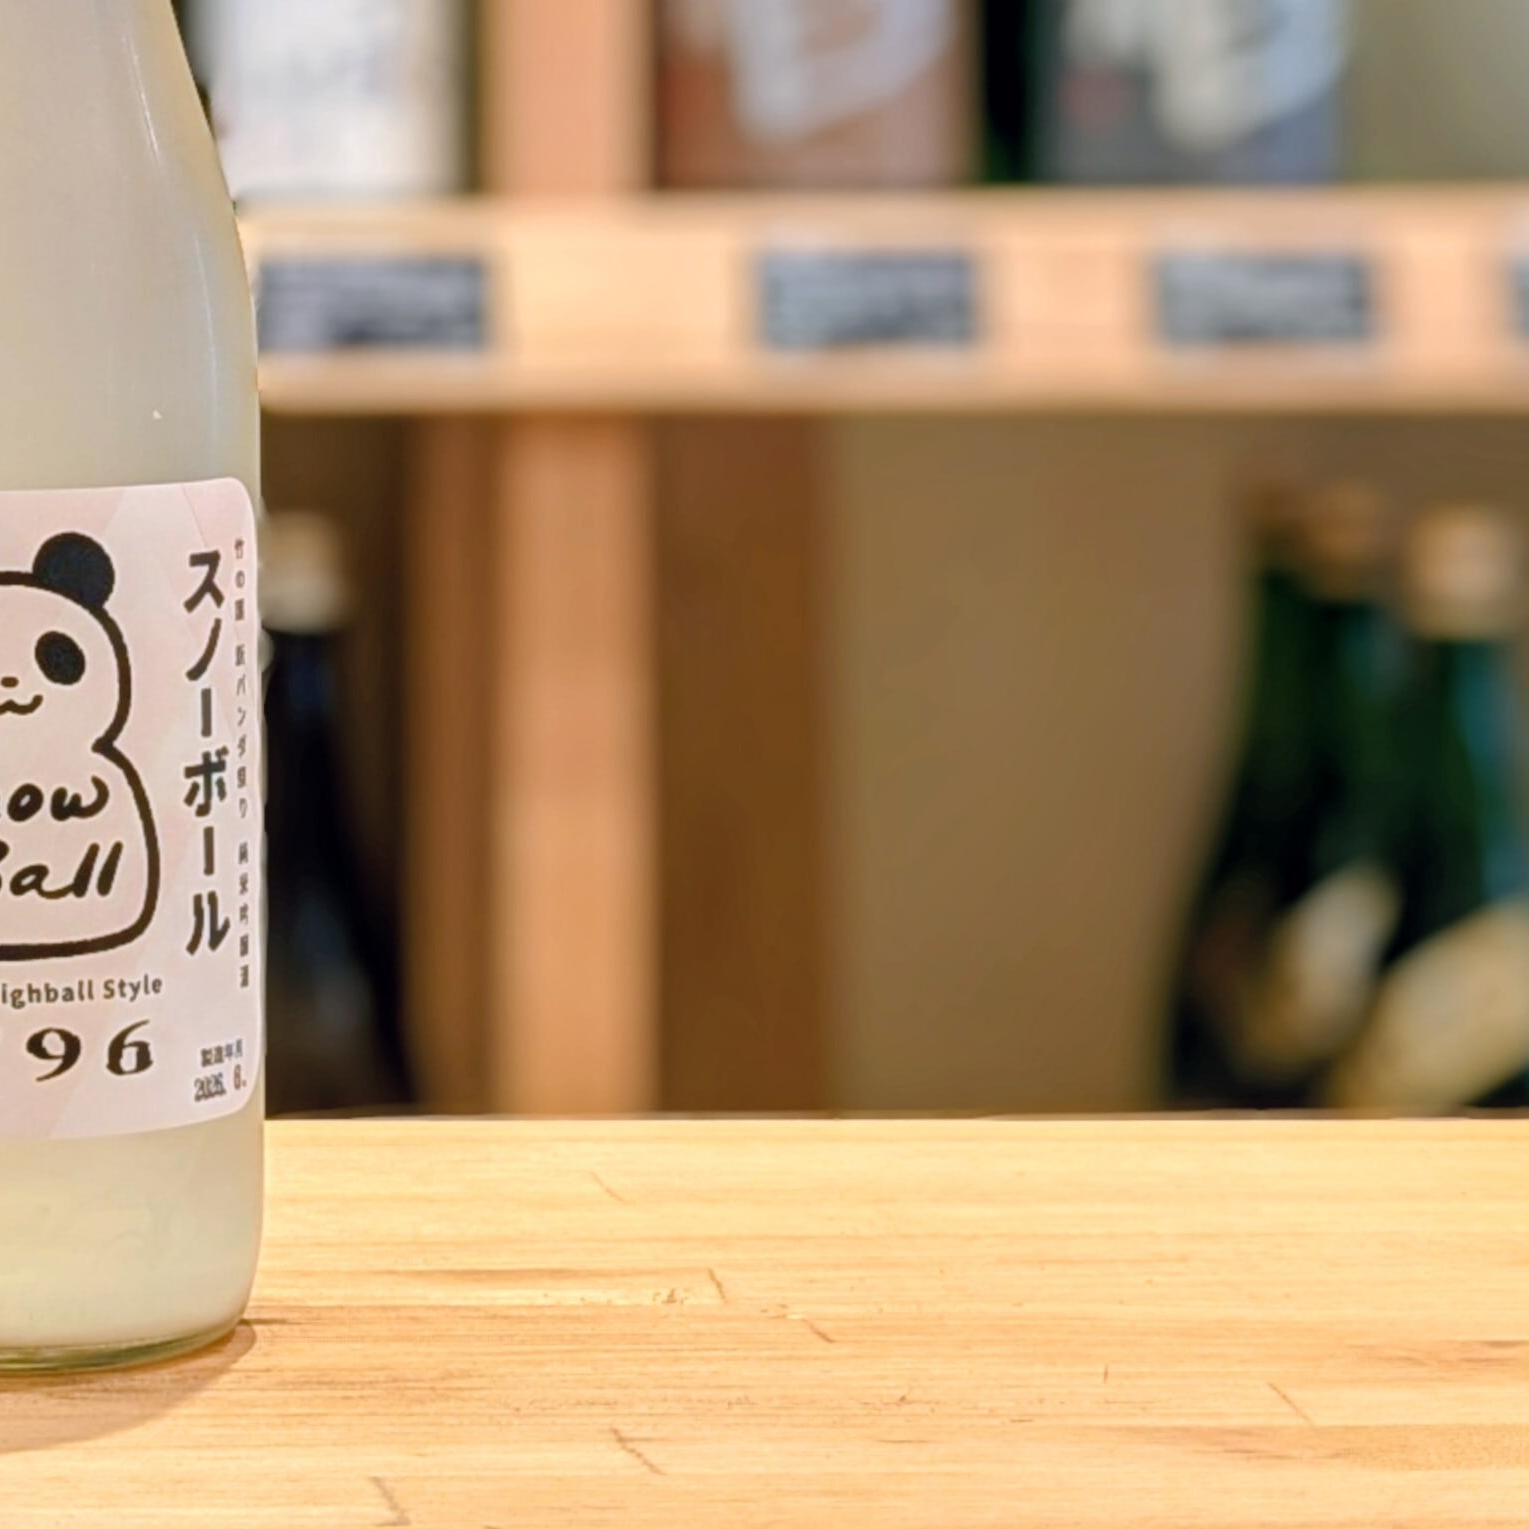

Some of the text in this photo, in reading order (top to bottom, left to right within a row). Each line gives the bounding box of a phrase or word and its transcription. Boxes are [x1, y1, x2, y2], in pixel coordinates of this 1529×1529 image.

[183, 549, 230, 956] スノーボール
[103, 974, 163, 1002] Style
